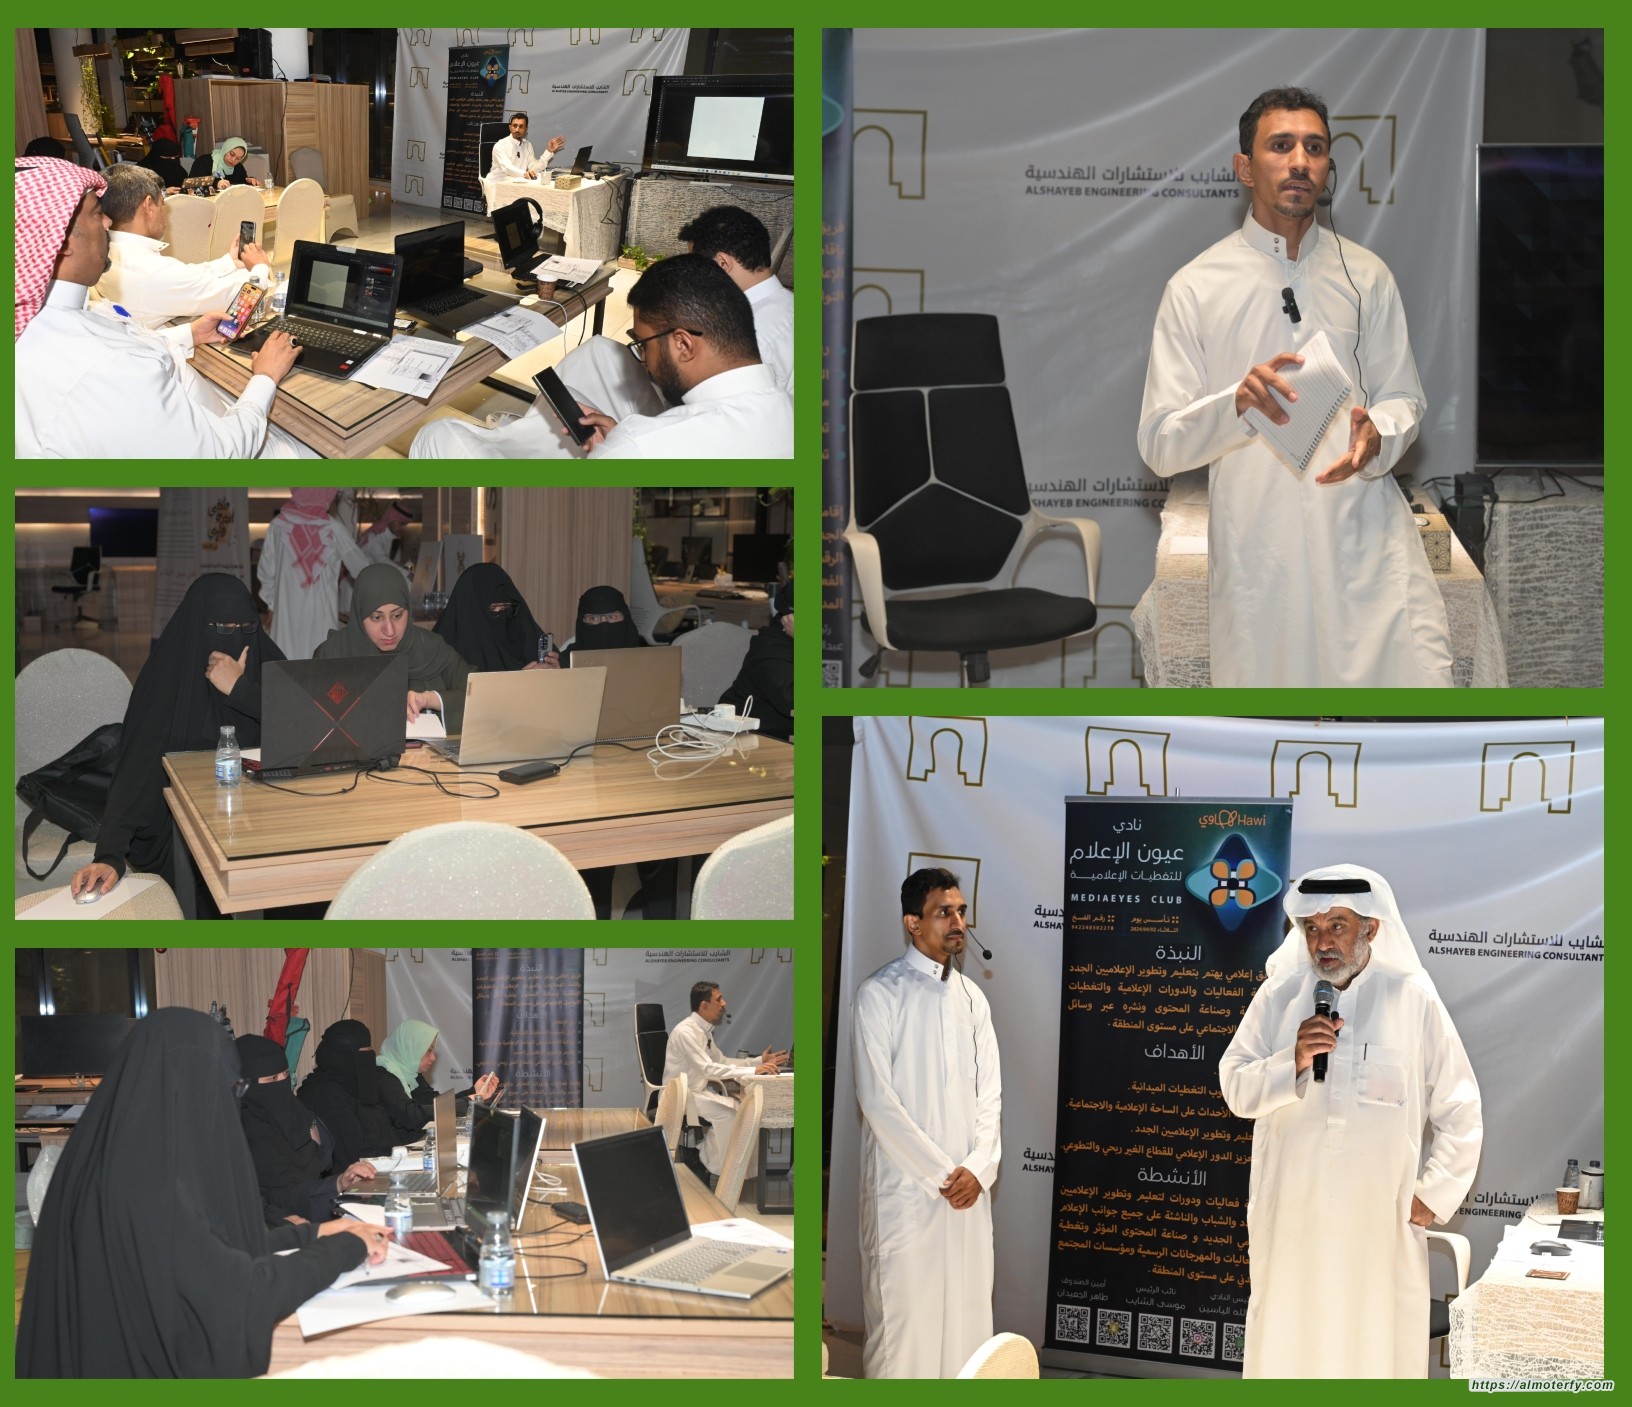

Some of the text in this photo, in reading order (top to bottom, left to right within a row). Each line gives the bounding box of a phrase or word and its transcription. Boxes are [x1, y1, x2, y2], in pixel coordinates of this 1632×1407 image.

[1025, 164, 1096, 182] الهندسية
[1025, 185, 1240, 199] ALSHAYEB CONSULTANTS
[1075, 498, 1149, 508] ENGINEERING
[1113, 818, 1142, 834] نادي
[1237, 814, 1267, 827] Hawi
[1069, 841, 1184, 865] عيون الإعلام
[1069, 870, 1183, 883] للتغطيات الإعلامية
[1070, 893, 1183, 905] MEDIAEYES CLUB
[1092, 914, 1106, 923] رقم
[1428, 929, 1564, 948] للاستشارات الهندسية
[709, 949, 731, 957] الشايب
[1155, 945, 1202, 961] النبذة
[1428, 946, 1604, 962] ALSHAYEB ENGINEERING CONSULTANT
[1069, 963, 1253, 982] إعلامي يهتم بتعليم وتطوير الإعلاميين الجدد
[1068, 981, 1244, 997] الفعاليات والدورات الإعلامية والتغطيات
[1067, 998, 1231, 1017] وصناعة المحتوى ونشره عبر وسائل
[1147, 1023, 1237, 1038] الاجتماعي على مستوى
[1144, 1043, 1205, 1061] الأهداف
[1168, 1085, 1207, 1096] التغطيات
[1115, 1101, 1148, 1114] الإعلامية
[1150, 1103, 1179, 1114] الساحة
[1181, 1107, 1195, 1118] على
[1197, 1105, 1231, 1119] الأحداث
[1161, 1127, 1231, 1141] وتطوير الإعلاميين
[1023, 1147, 1056, 1161] دسية
[1102, 1146, 1123, 1156] ربحي
[1123, 1145, 1145, 1156] الغير
[1146, 1146, 1174, 1158] للقطاع
[1175, 1150, 1208, 1162] الإعلامي
[1210, 1152, 1232, 1163] الدور
[1022, 1163, 1055, 1173] ALSHAY
[1137, 1166, 1207, 1187] الأنشطة
[1059, 1185, 1240, 1208] فعاليات ودورات لتعليم وتطوير الإعلاميين
[1059, 1202, 1237, 1228] والشباب والناشئة على جميع جوانب الإعلام
[1459, 1208, 1522, 1219] ENGINEERING
[1058, 1220, 1089, 1234] وتغطية
[1093, 1223, 1118, 1235] المؤثر
[1121, 1225, 1157, 1238] المحتوى
[1161, 1229, 1188, 1240] صناعة
[1192, 1234, 1199, 1244] و
[1202, 1232, 1233, 1246] الجديد
[1057, 1239, 1221, 1264] والمهرجانات الرسمية ومؤسسات المجتمع
[1061, 1276, 1107, 1288] أمين الصندوق
[1187, 1271, 1235, 1285] على مستوى
[1088, 1291, 1109, 1301] طاهر
[1135, 1285, 1177, 1296] نائب الرئيس
[1125, 1296, 1186, 1311] موسى الشايب
[1209, 1293, 1230, 1303] النادي
[1198, 1304, 1226, 1316] الياسين
